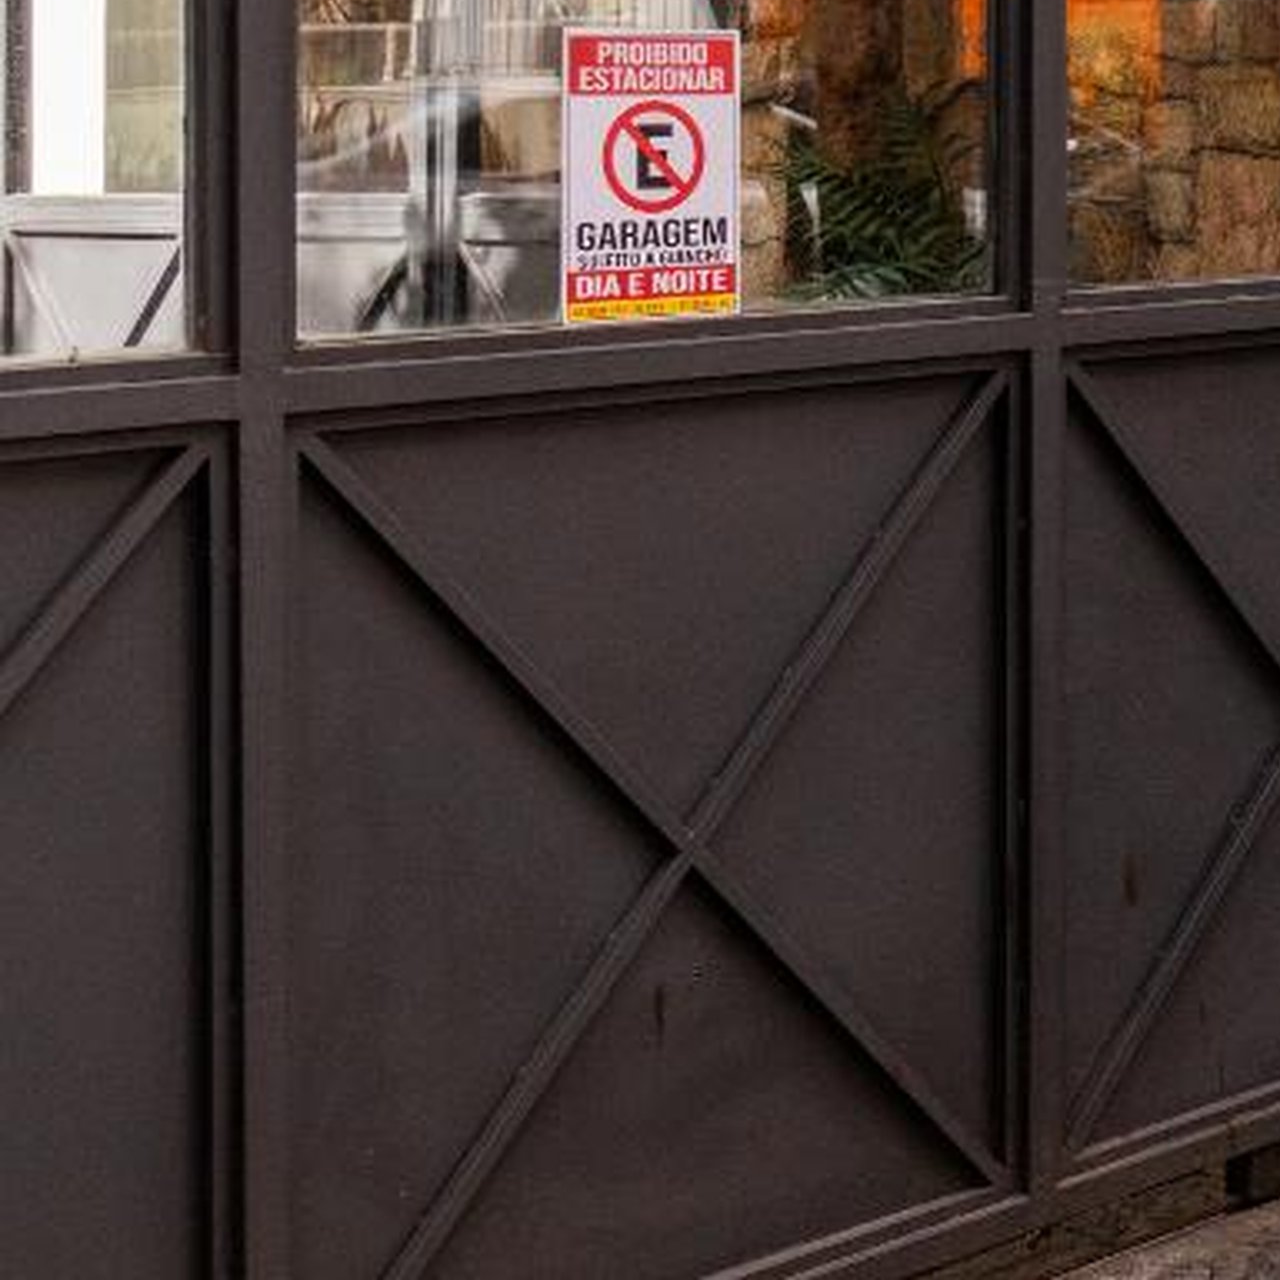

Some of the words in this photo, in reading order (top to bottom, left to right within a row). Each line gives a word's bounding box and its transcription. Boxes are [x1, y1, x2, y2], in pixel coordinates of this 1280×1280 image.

[597, 41, 708, 65] PROIBIDO
[579, 66, 725, 91] ESTACIONAR
[577, 216, 729, 251] GARAGEM
[575, 272, 622, 300] DIA
[628, 272, 645, 297] E
[652, 269, 729, 295] NOITE
